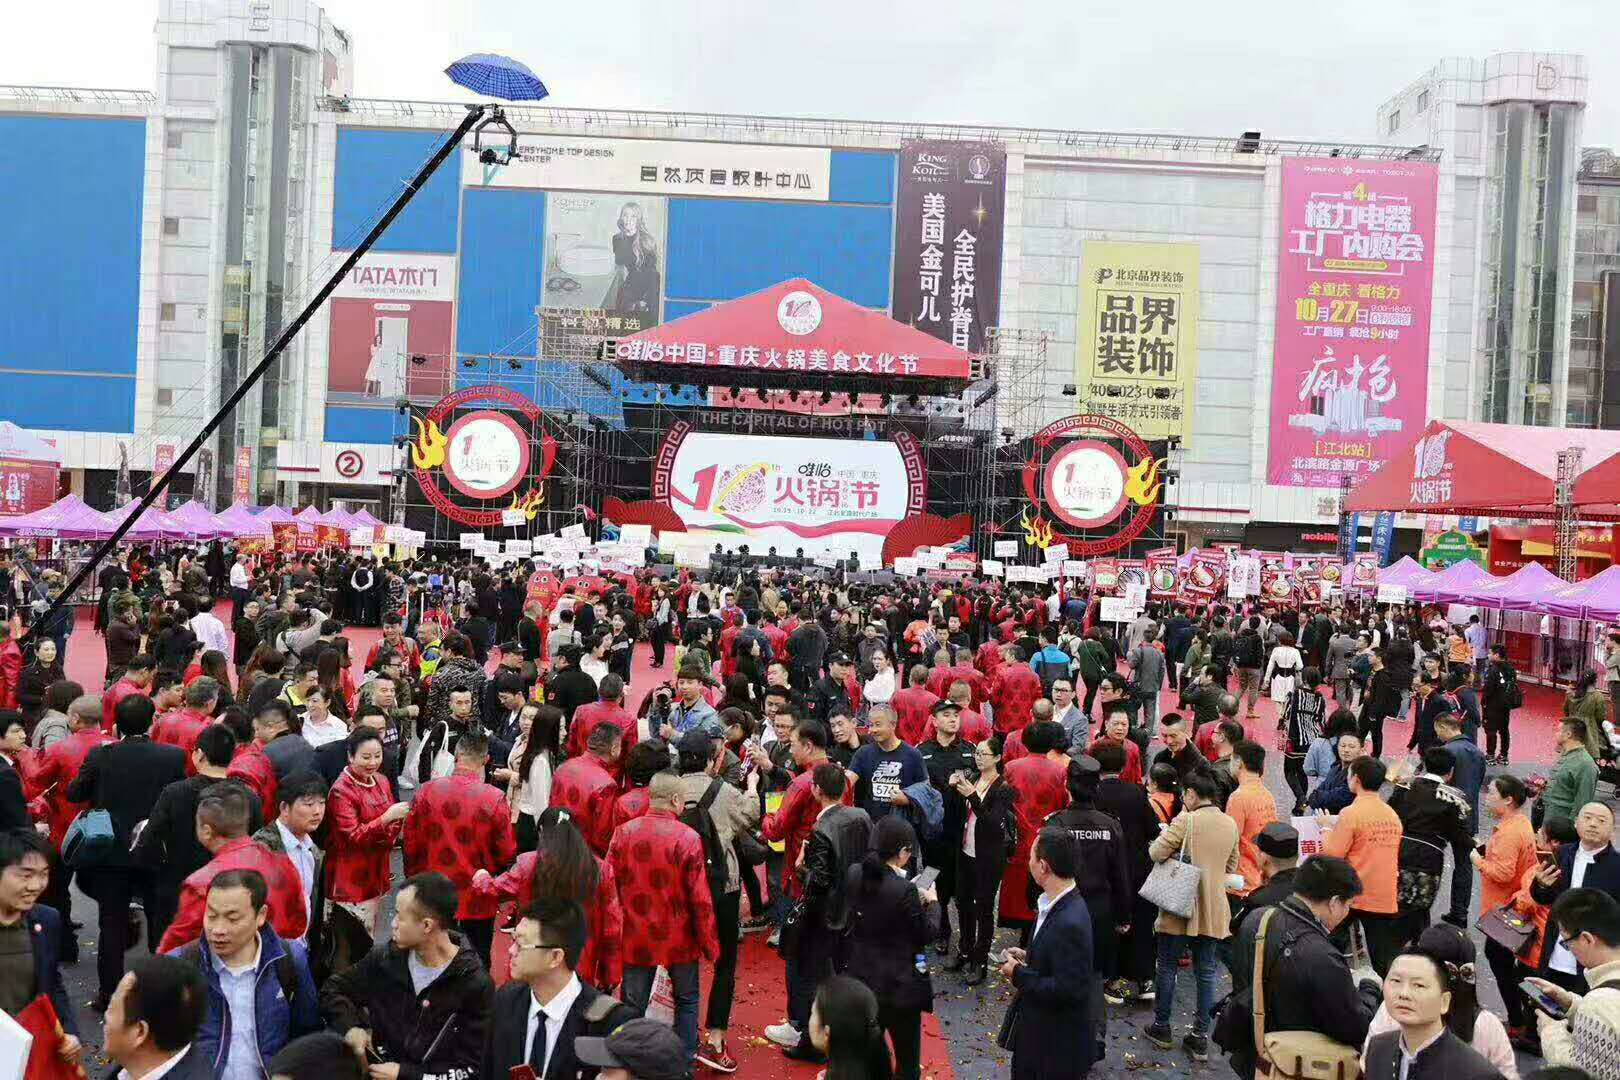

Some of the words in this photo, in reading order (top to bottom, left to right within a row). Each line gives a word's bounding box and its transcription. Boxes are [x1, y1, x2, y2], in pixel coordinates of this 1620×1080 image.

[918, 153, 947, 163] KING
[1304, 200, 1412, 233] 格力电器
[917, 192, 946, 322] 美国金可儿
[1288, 230, 1425, 262] 工厂内购会
[1115, 268, 1185, 284] 北京品界装饰
[1100, 294, 1177, 336] 品界
[1295, 298, 1370, 324] 10月27日
[1097, 335, 1176, 377] 装饰
[702, 410, 728, 424] THE
[733, 413, 796, 429] CAPITAL
[799, 415, 818, 431] OF
[822, 417, 852, 431] HOT
[871, 770, 902, 784] Classic
